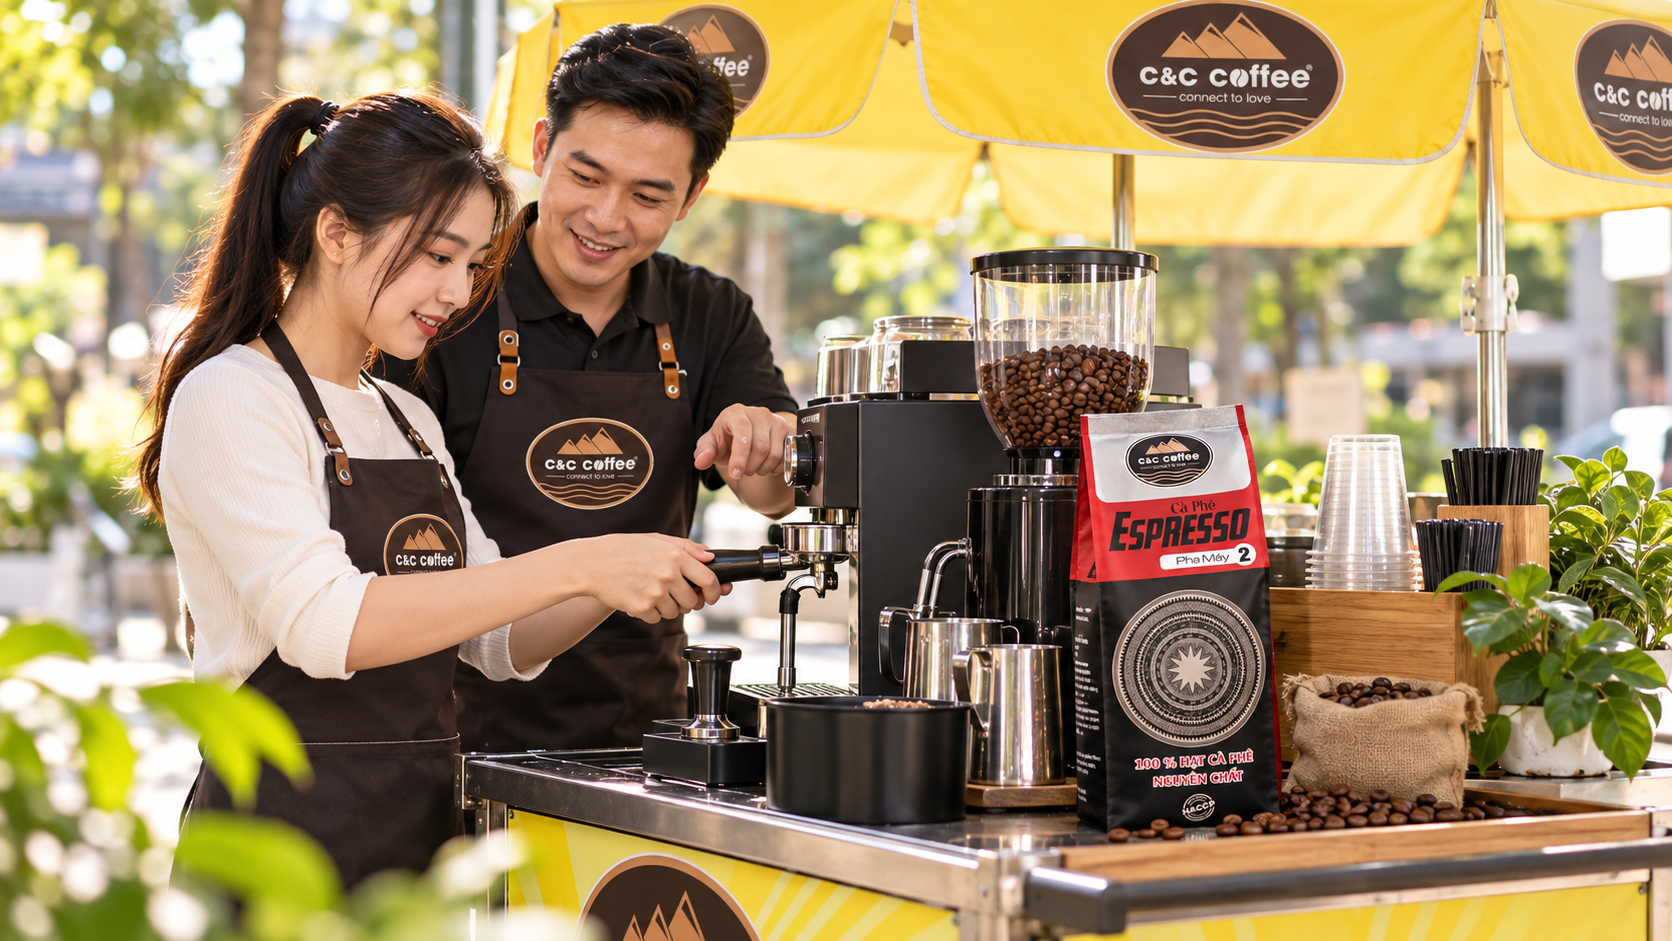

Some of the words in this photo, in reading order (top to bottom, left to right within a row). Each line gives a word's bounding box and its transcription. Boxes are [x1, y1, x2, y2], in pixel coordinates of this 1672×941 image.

[1179, 93, 1228, 103] connect
[1231, 93, 1243, 103] to
[1246, 93, 1271, 104] love
[1619, 113, 1650, 125] connect
[1651, 115, 1660, 126] to
[1109, 507, 1251, 551] ESPRESSO
[1176, 555, 1200, 565] Pha
[1238, 547, 1251, 562] 2
[1134, 758, 1161, 770] 100
[1163, 756, 1178, 769] %
[1207, 751, 1227, 766] CÀ
[1229, 748, 1254, 764] PHÊ
[1153, 770, 1207, 788] NGUYÊN
